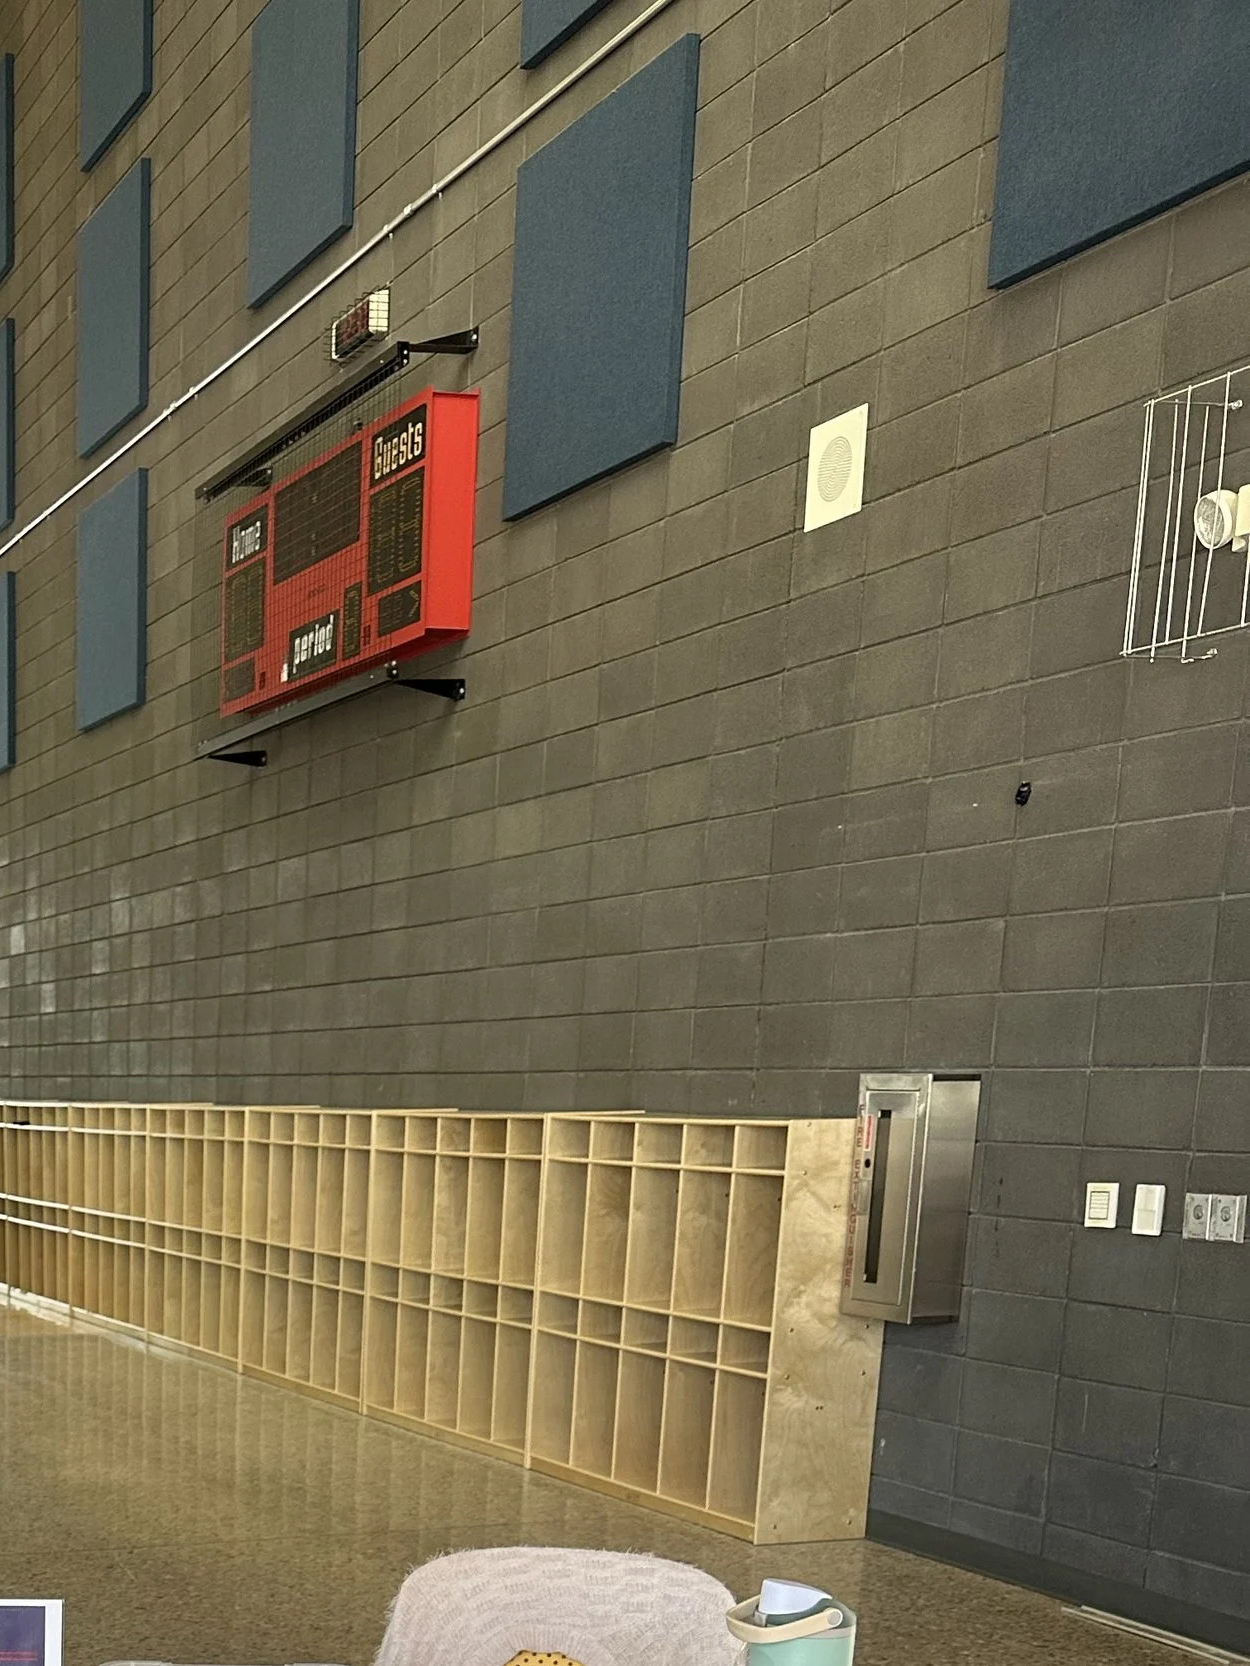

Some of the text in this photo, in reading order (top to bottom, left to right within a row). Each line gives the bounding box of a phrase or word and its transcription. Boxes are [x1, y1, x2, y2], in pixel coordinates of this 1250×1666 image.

[374, 421, 423, 480] Guests
[292, 614, 335, 675] period
[856, 1103, 865, 1148] FIRE
